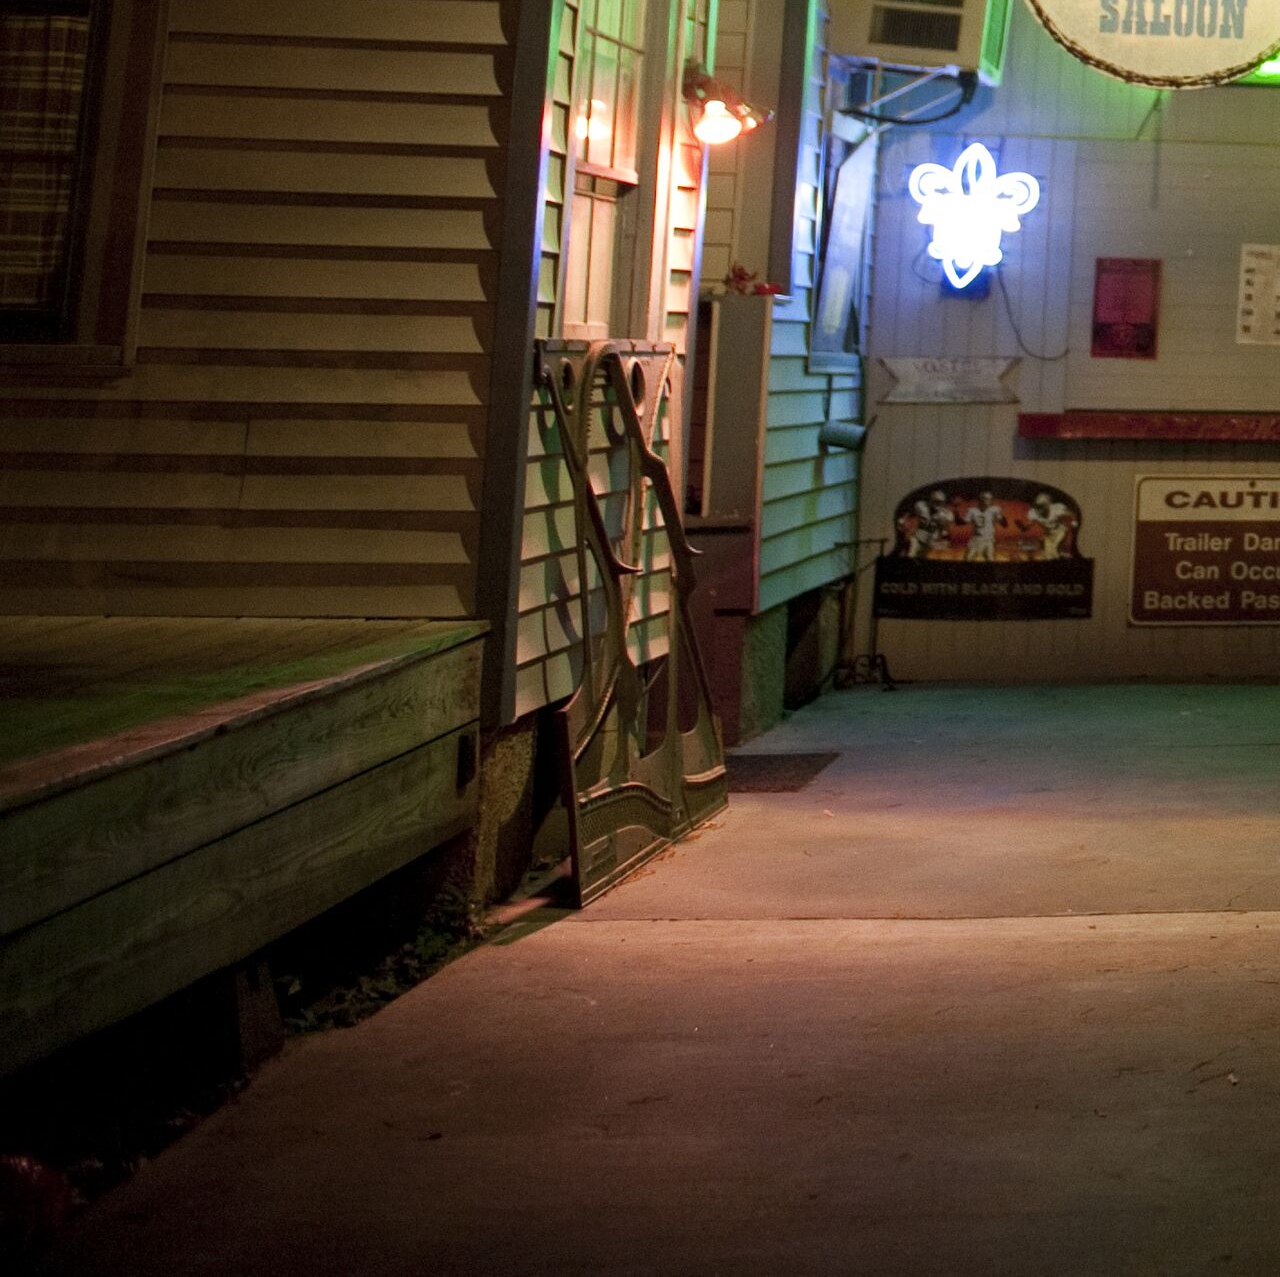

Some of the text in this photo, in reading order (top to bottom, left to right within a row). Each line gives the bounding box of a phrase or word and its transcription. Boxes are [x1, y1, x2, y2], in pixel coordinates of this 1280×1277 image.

[1164, 532, 1233, 552] Trailer
[1175, 560, 1220, 581] Can
[961, 582, 1009, 596] BLACK
[1142, 590, 1231, 610] Backed
